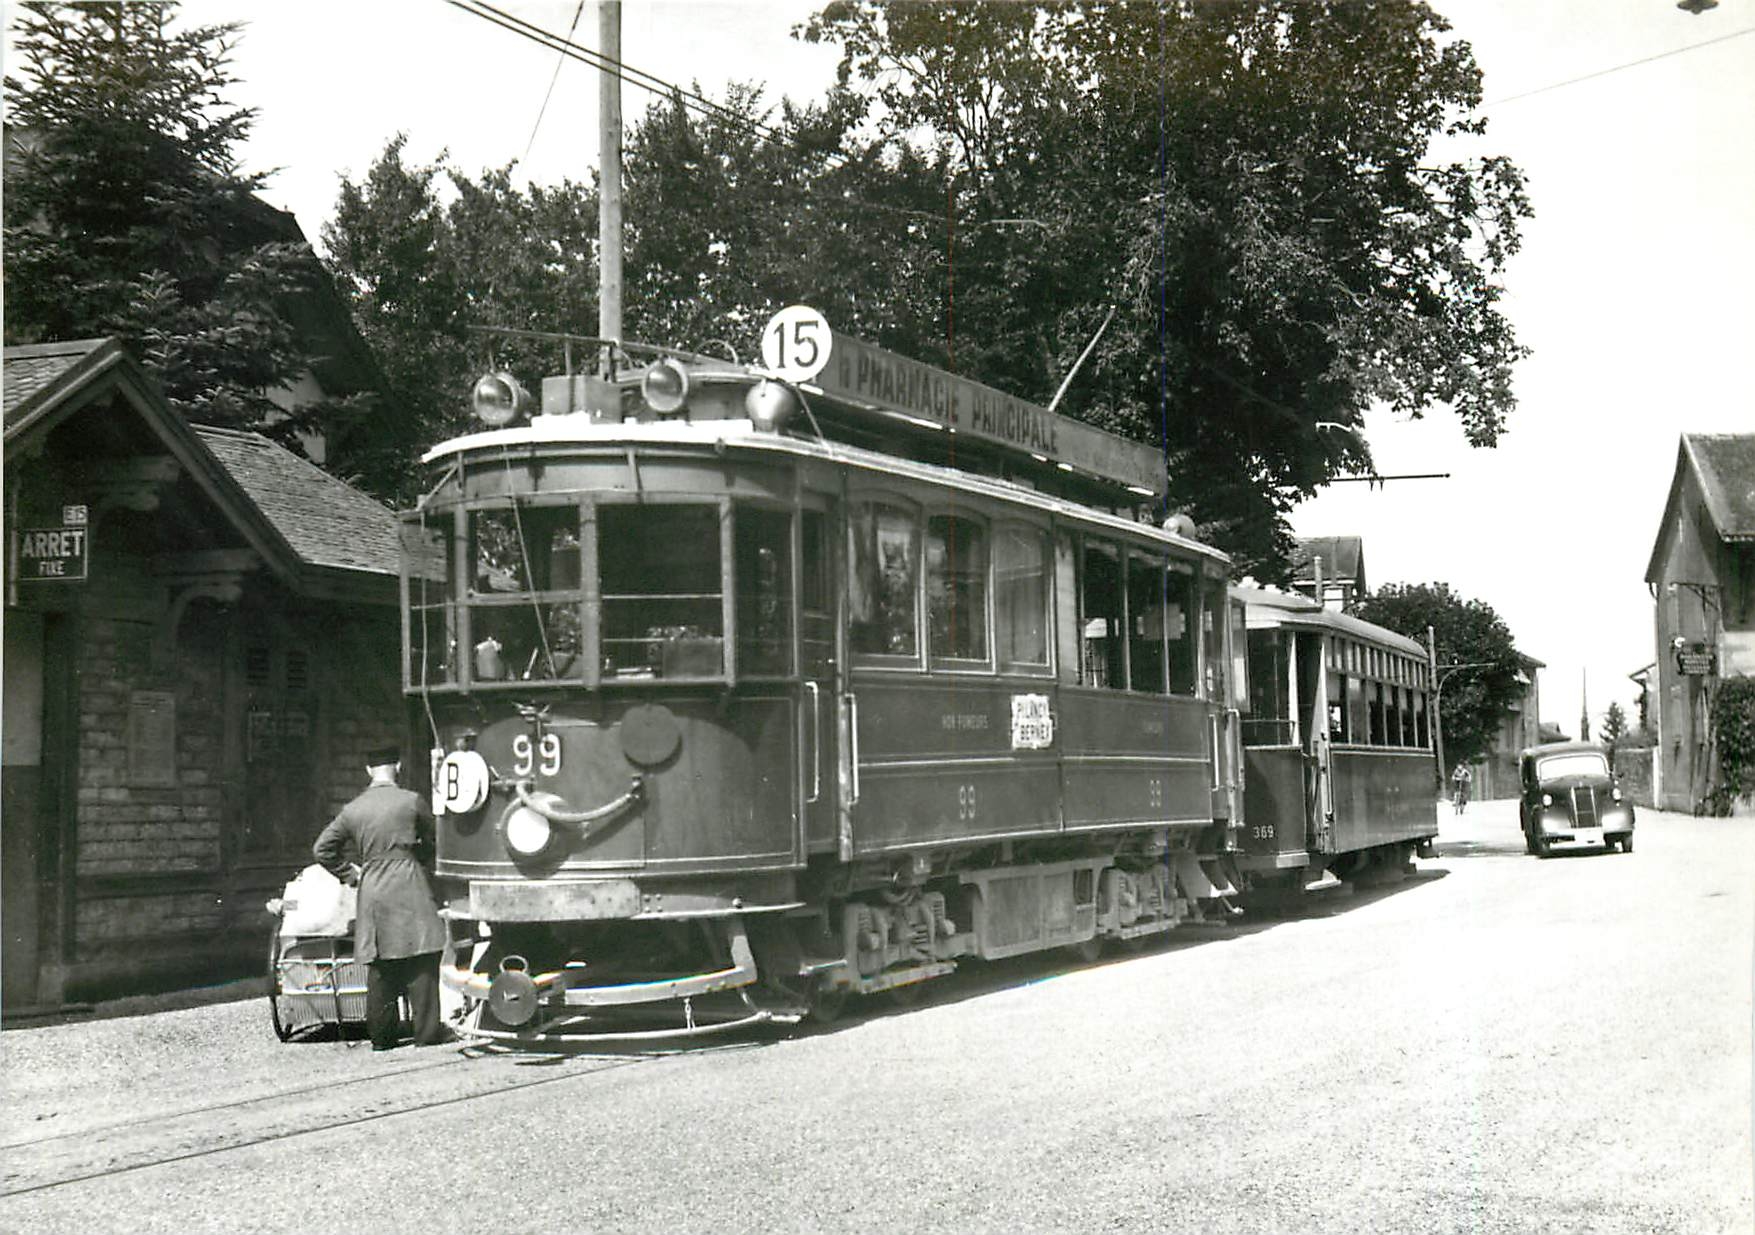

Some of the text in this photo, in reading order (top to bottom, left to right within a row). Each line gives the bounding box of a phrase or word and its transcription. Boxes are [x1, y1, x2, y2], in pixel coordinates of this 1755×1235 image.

[772, 319, 820, 369] 15
[857, 350, 959, 423] PHARMACIE
[971, 391, 1059, 455] PRINCIPALE
[21, 529, 84, 558] ARRET
[513, 733, 561, 776] 99
[447, 762, 459, 800] B
[1252, 824, 1274, 839] 369
